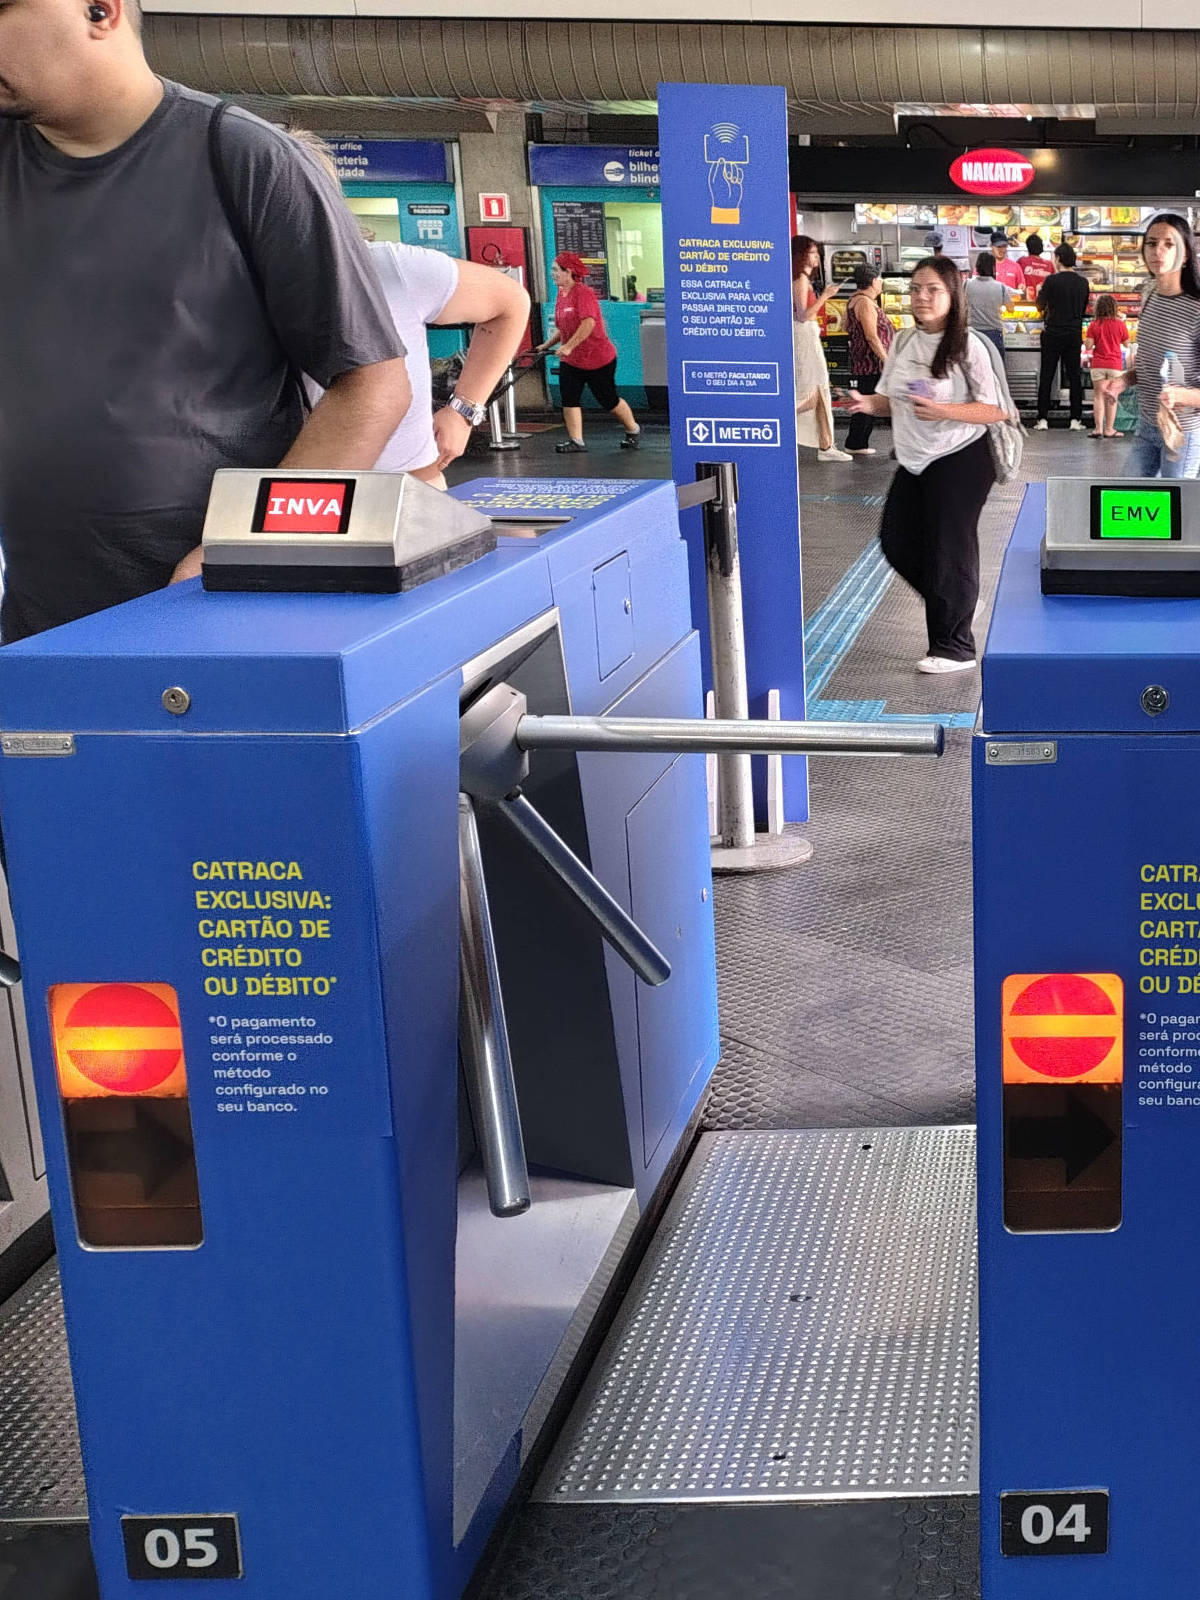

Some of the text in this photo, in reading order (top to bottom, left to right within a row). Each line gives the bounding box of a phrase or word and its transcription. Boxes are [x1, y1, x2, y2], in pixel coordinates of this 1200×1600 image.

[340, 142, 362, 150] office
[336, 167, 365, 177] dada
[630, 161, 658, 172] bilhe
[962, 162, 1033, 182] NAKATA
[631, 174, 659, 184] blind
[679, 238, 774, 249] CATRACA EXCLUSIVA:
[680, 250, 770, 262] CARTÃO DE CRÉDITO
[680, 263, 728, 273] OU DÉBITO
[705, 280, 742, 288] CATRACA
[745, 280, 750, 289] É
[682, 292, 726, 300] EXCLUSIVA
[752, 292, 774, 302] VOCÊ
[682, 304, 714, 312] PASSAR
[710, 315, 742, 324] CARTÃO
[683, 327, 766, 336] CRÉDITO OU DÉBITO.
[719, 424, 773, 440] METRÔ
[268, 498, 341, 516] INVA
[1112, 506, 1160, 522] EMV
[192, 861, 303, 880] CATRACA
[196, 890, 332, 909] EXCLUSIVA:
[198, 916, 331, 938] CARTÃO DE
[202, 944, 302, 966] CRÉDITO
[204, 977, 238, 996] OU
[1140, 976, 1170, 994] OU
[231, 1016, 316, 1030] pagamento
[210, 1033, 332, 1046] será processado
[1139, 1030, 1168, 1040] será
[212, 1050, 296, 1061] conforme o
[1139, 1062, 1192, 1072] método
[214, 1068, 270, 1078] método
[216, 1084, 328, 1098] configurado no
[217, 1101, 298, 1112] seu banco.
[1138, 1097, 1162, 1106] seu
[1021, 1504, 1091, 1544] 04
[144, 1528, 218, 1568] 05
